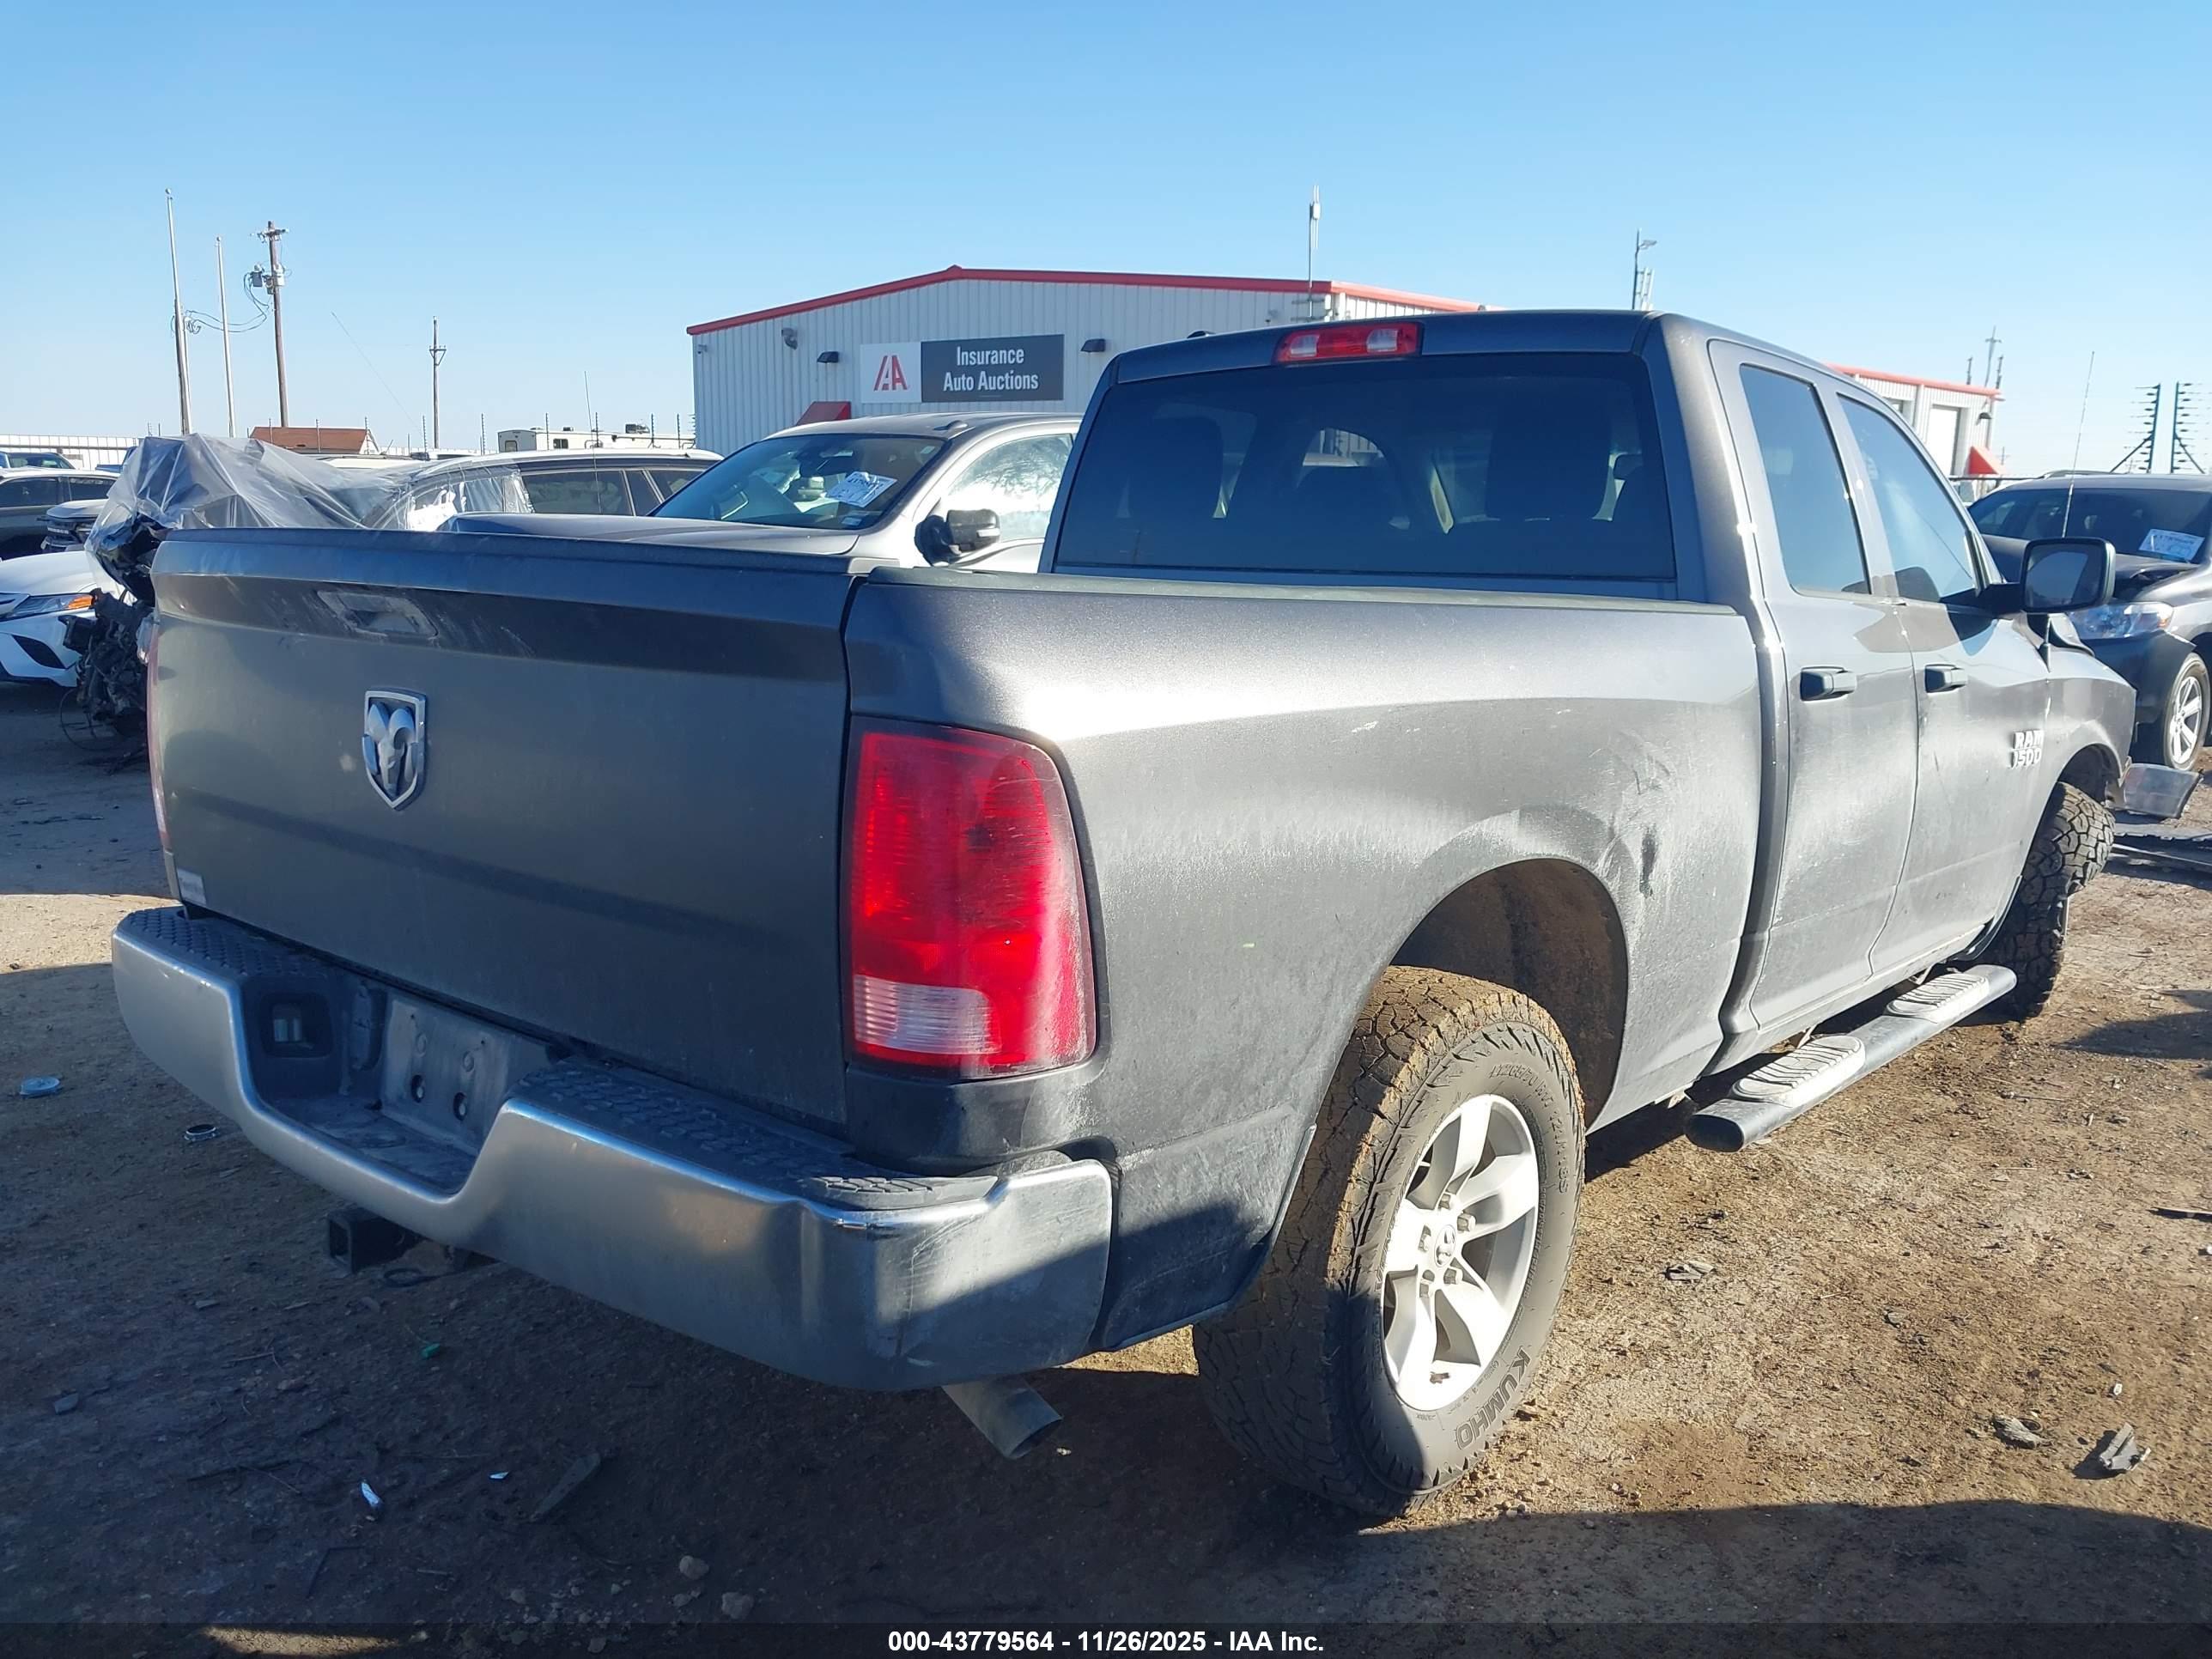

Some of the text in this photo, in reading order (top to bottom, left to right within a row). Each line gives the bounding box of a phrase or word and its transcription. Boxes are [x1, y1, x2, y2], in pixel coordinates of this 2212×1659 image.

[957, 346, 1024, 366] Insurance
[943, 370, 1039, 392] Auto Auctions
[2012, 729, 2045, 750] RAM
[2010, 748, 2042, 769] 1500
[1455, 1346, 1531, 1449] KUMHO
